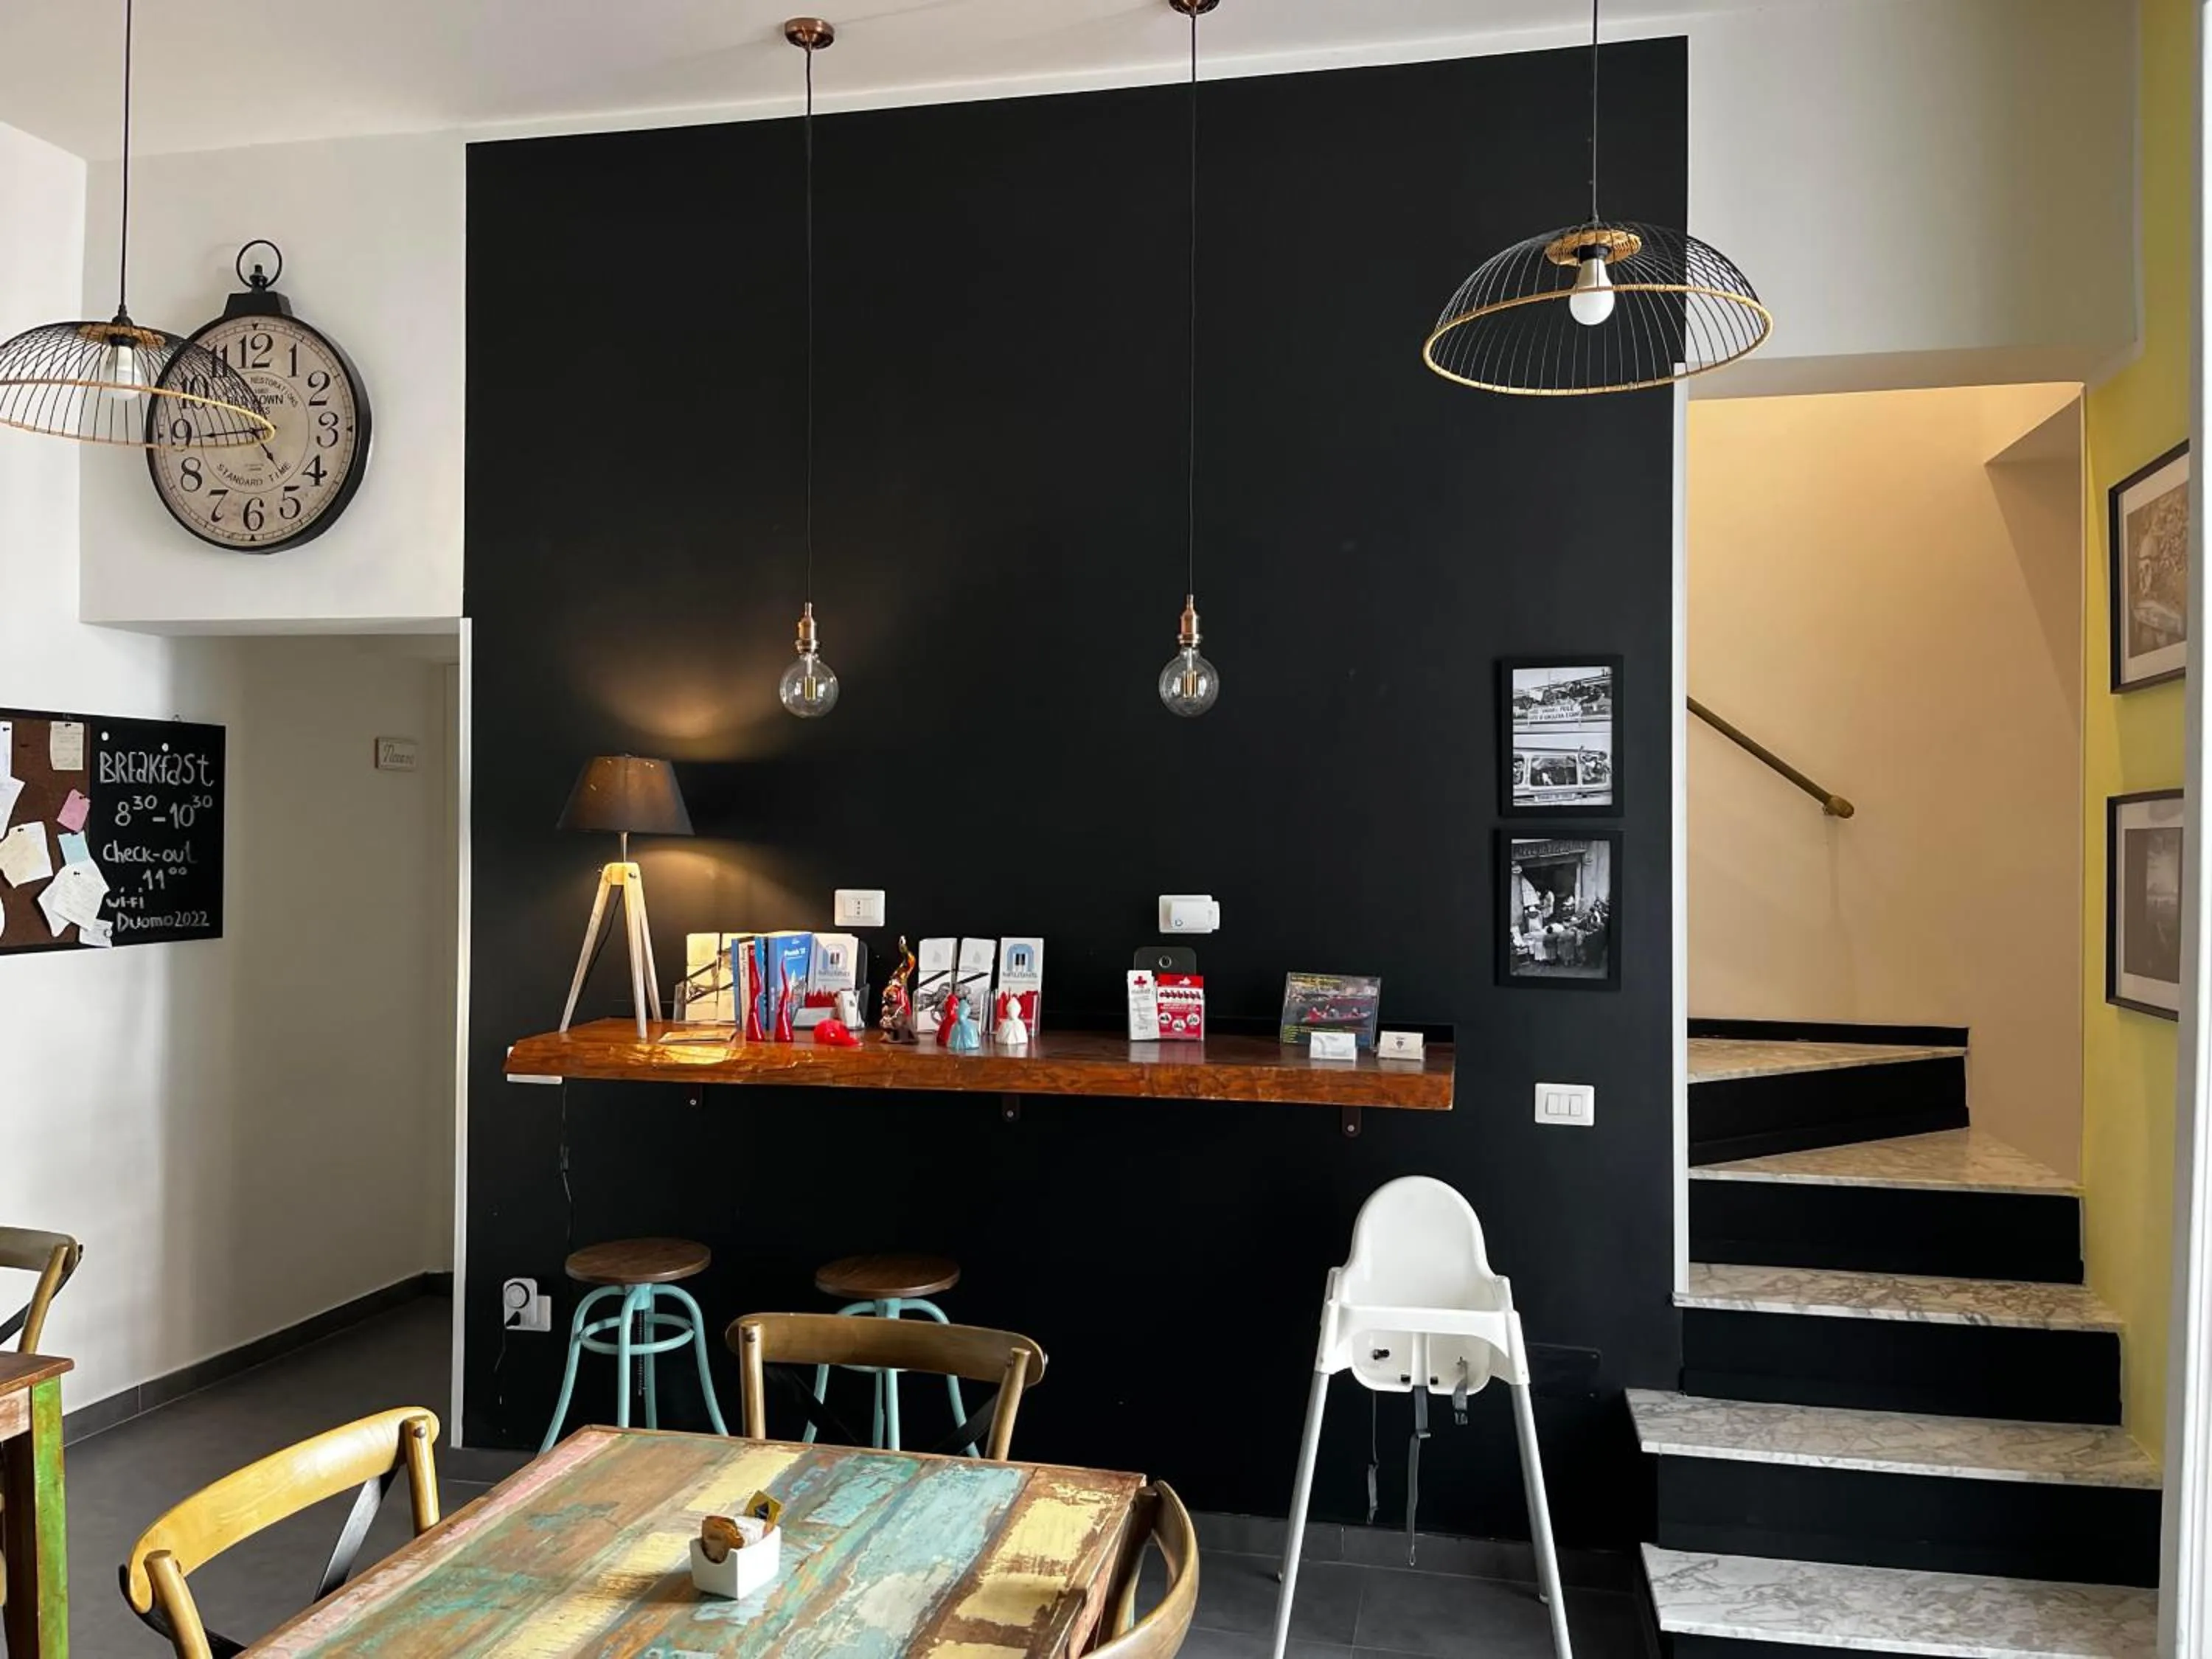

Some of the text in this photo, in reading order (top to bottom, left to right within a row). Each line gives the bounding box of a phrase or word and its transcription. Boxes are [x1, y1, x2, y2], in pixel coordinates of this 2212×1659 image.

[238, 333, 274, 369] 12
[288, 344, 299, 378] 1
[182, 375, 209, 409] 10
[307, 370, 330, 406] 2
[171, 418, 192, 451] 9
[316, 411, 338, 448] 3
[181, 457, 202, 492] 8
[217, 462, 291, 486] STANDARD TIME
[302, 454, 327, 487] 4
[209, 489, 229, 522] 7
[243, 497, 264, 531] 6
[279, 486, 301, 519] 5
